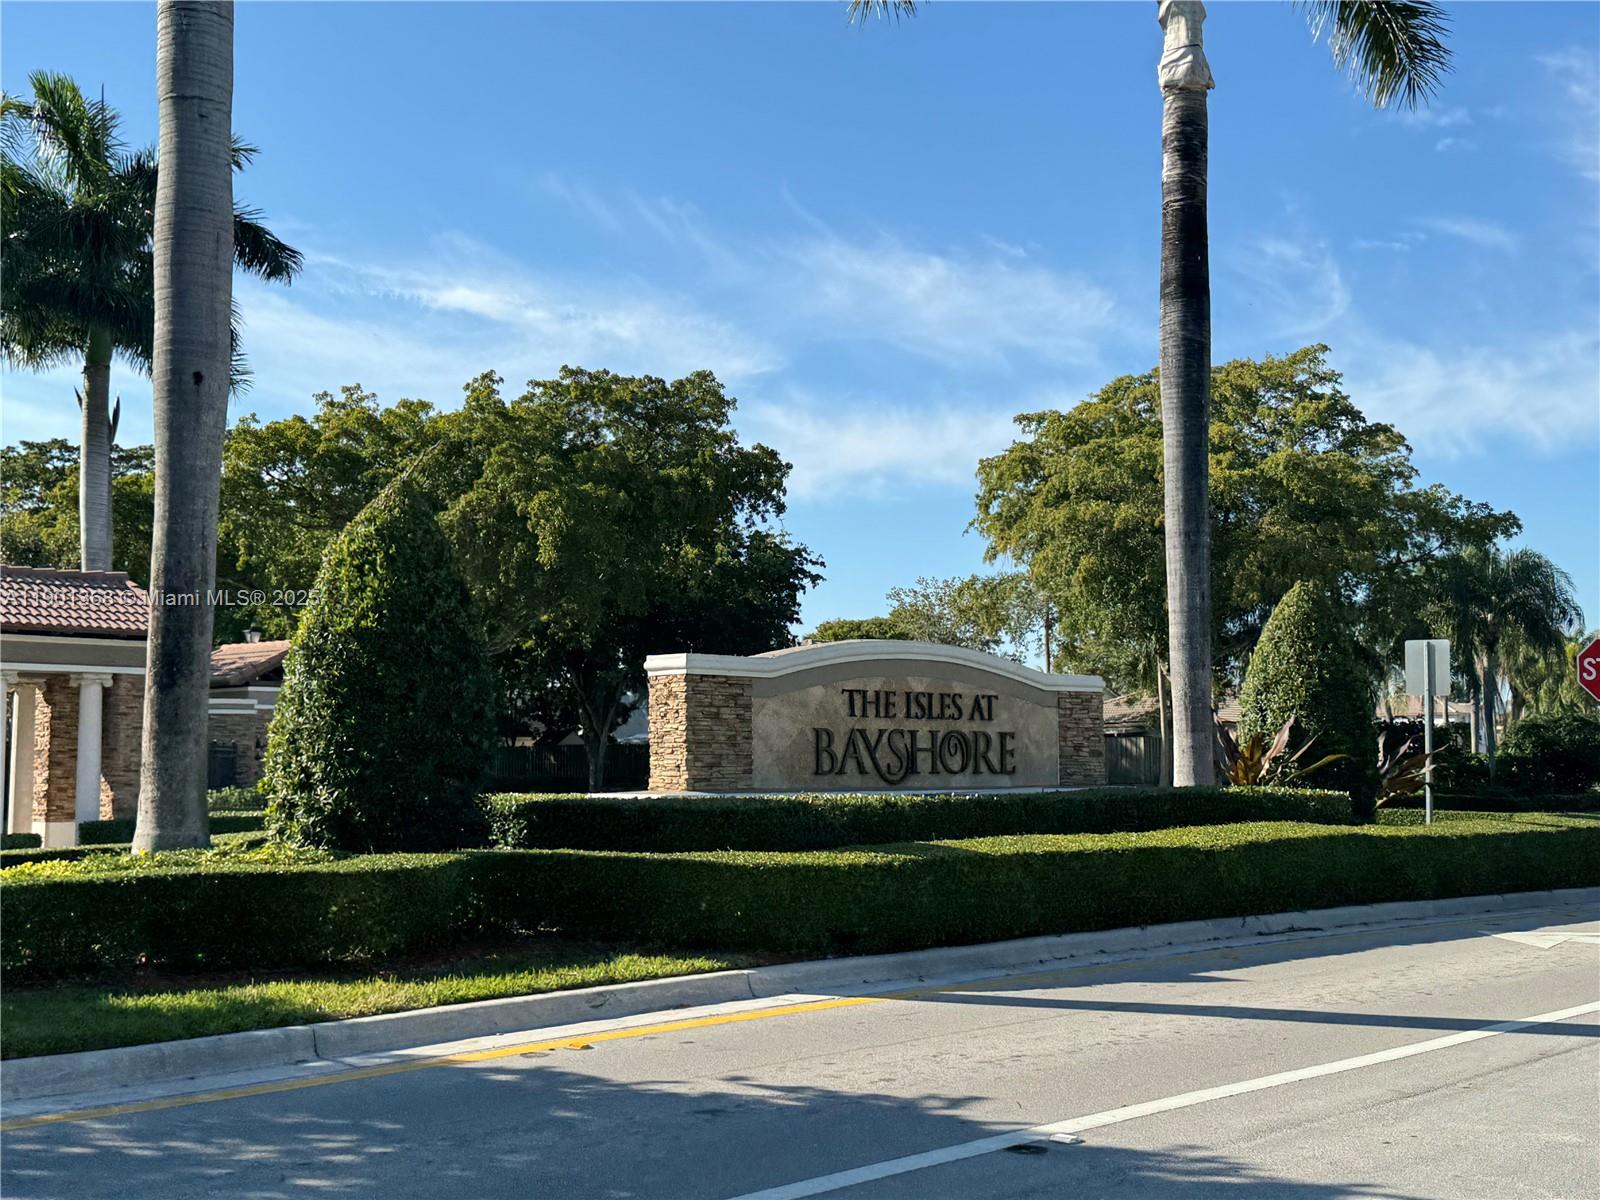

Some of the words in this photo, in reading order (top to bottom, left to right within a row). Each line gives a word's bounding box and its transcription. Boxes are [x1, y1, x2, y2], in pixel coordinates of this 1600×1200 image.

[841, 688, 897, 719] THE
[904, 691, 963, 721] ISLES
[968, 694, 998, 721] AT
[812, 727, 1016, 785] BAYSHORE
